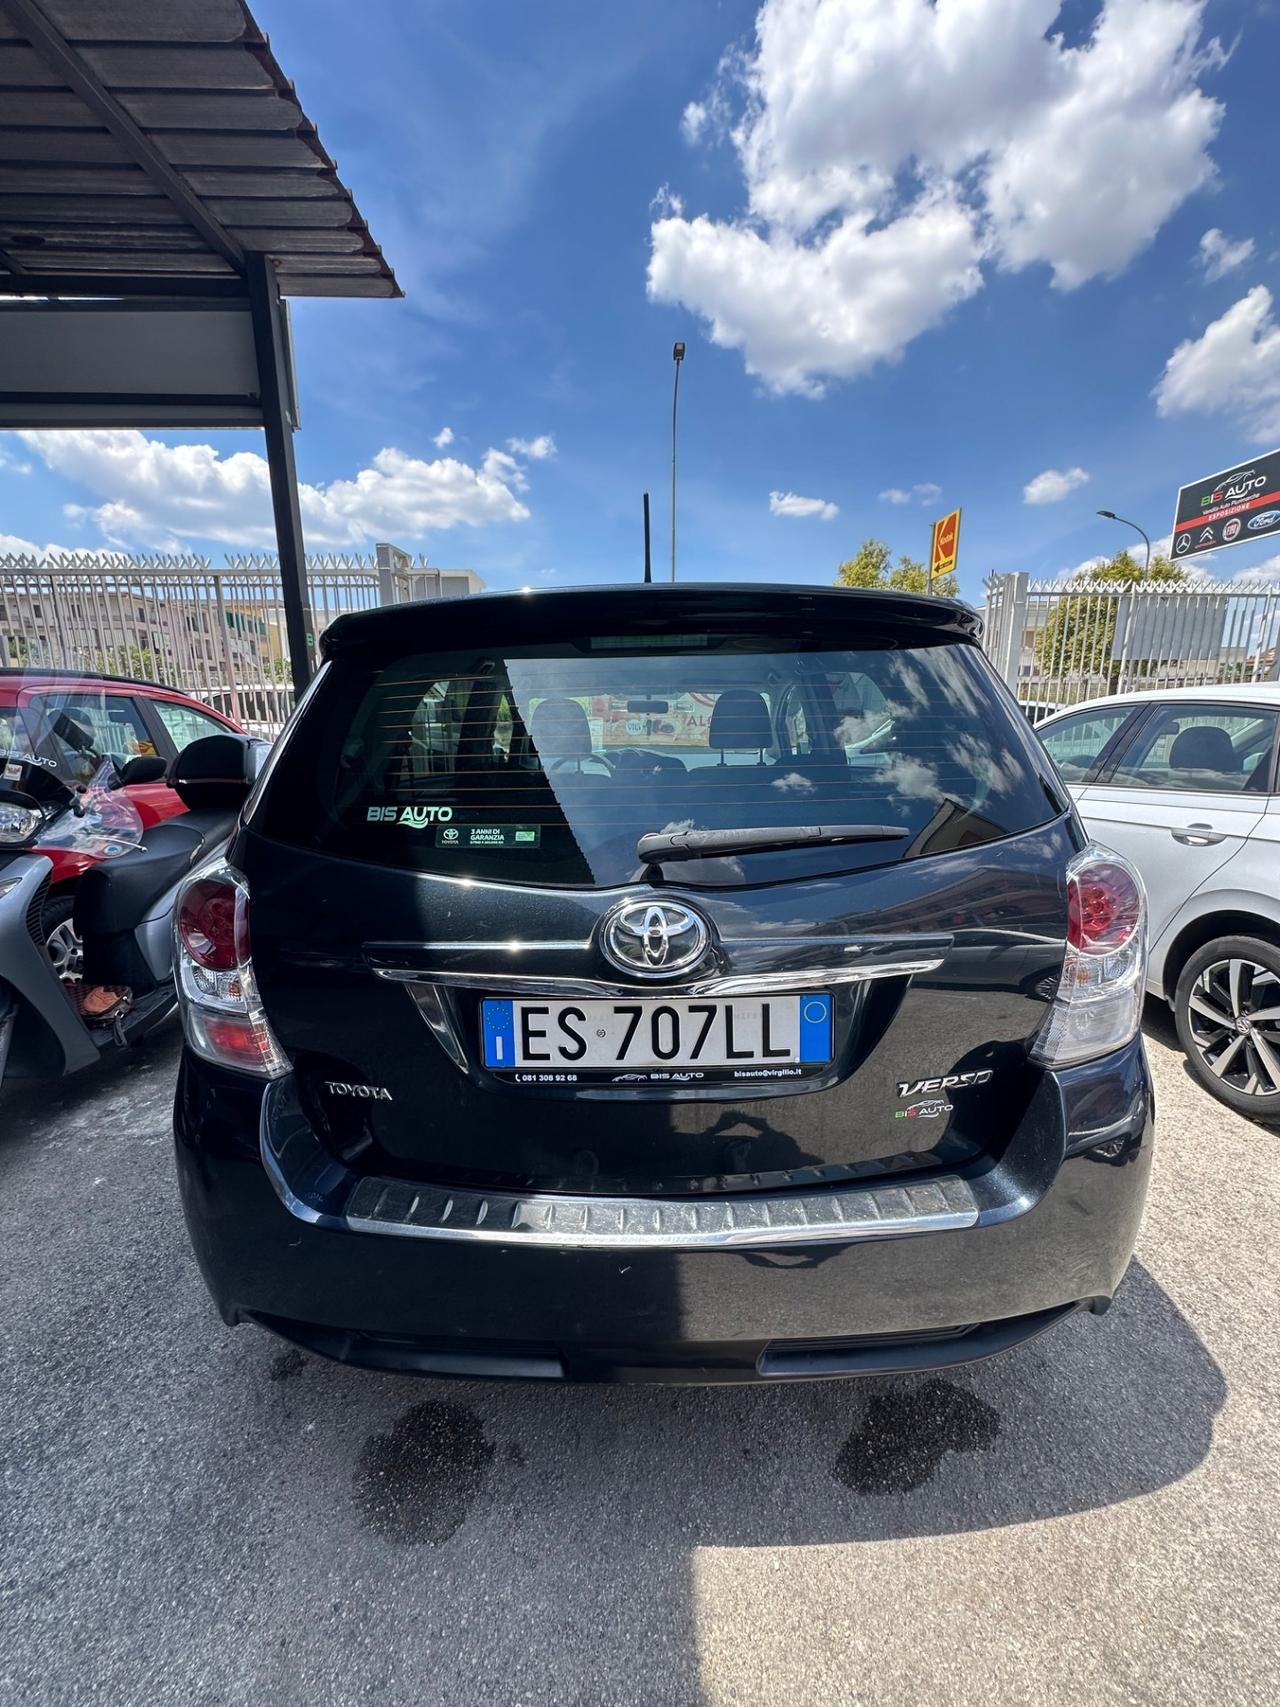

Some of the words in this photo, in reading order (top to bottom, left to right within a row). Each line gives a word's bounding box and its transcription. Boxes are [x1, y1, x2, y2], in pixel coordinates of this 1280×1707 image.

[1201, 490, 1224, 507] BIS
[1225, 476, 1267, 501] AUTO
[1208, 503, 1251, 521] ESPOSIZIONE
[1254, 513, 1276, 528] Ford
[22, 753, 58, 767] AUTO
[366, 806, 398, 821] BIS
[398, 806, 453, 825] AUTO
[521, 1006, 588, 1061] ES
[613, 1003, 791, 1061] 707LL
[522, 1074, 537, 1082] 081
[555, 1074, 566, 1082] 92
[670, 1072, 704, 1081] AUTO
[734, 1068, 802, 1077] bisauto@virgilio.it
[324, 1081, 393, 1100] TOYOTA
[898, 1069, 993, 1097] VERSO
[895, 1108, 917, 1118] BIS
[918, 1104, 954, 1117] AUTO
